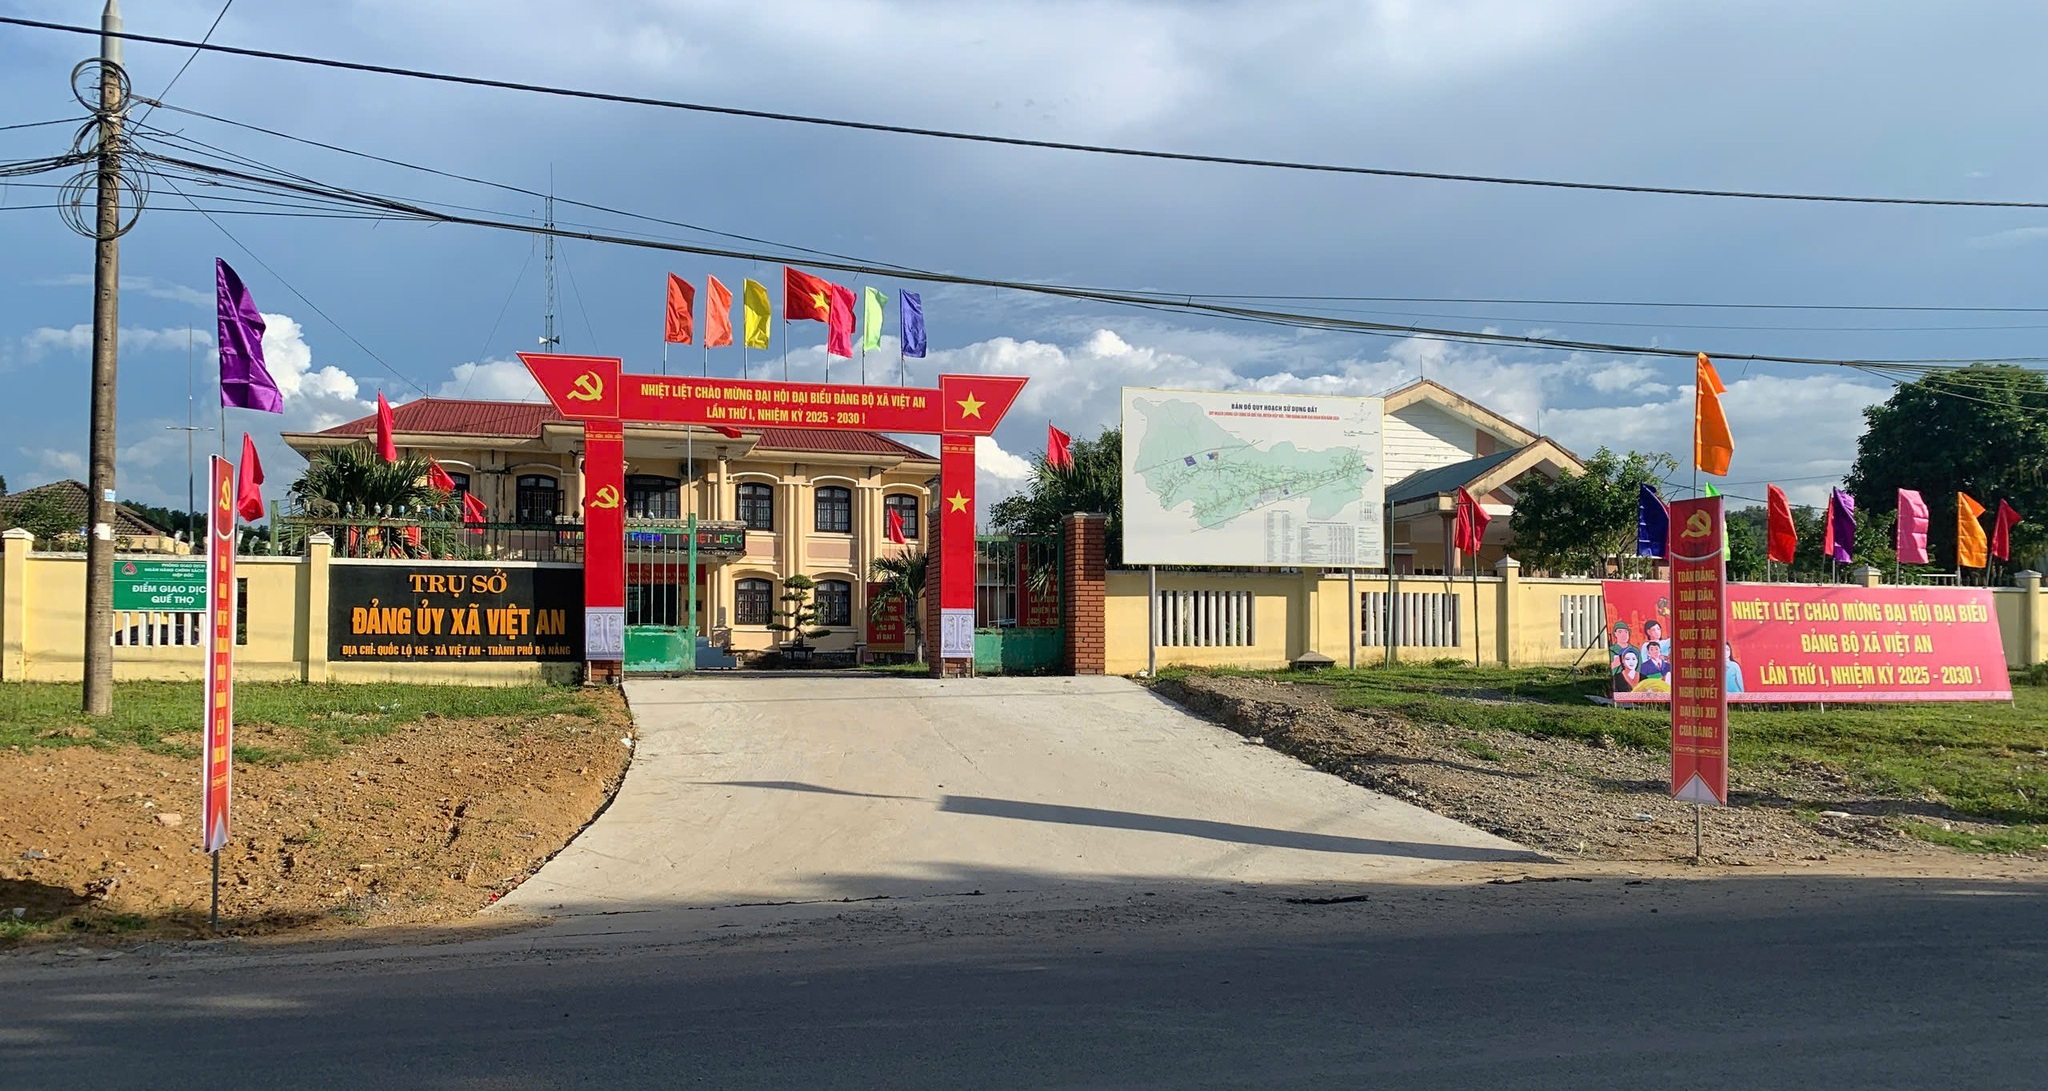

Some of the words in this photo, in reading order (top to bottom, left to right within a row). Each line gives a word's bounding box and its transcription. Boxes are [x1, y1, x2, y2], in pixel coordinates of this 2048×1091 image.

[641, 382, 669, 399] NHIỆT
[673, 383, 692, 400] LIỆT
[695, 385, 721, 399] CHÀO
[724, 386, 752, 401] MỪNG
[755, 389, 770, 404] ĐẠI
[774, 388, 789, 405] HỘI
[792, 391, 807, 405] ĐẠI
[810, 388, 831, 404] BIỂU
[834, 389, 859, 405] ĐẢNG
[862, 392, 874, 408] BỘ
[877, 394, 889, 406] XÃ
[891, 393, 910, 410] VIỆT
[913, 396, 925, 408] AN
[728, 405, 747, 419] THỨ
[749, 408, 755, 421] I,
[758, 407, 788, 423] NHIỆM
[791, 408, 803, 422] KỲ
[806, 411, 828, 423] 2025
[837, 412, 860, 424] 2030
[862, 413, 865, 424] !
[1677, 568, 1695, 582] TOÀN
[1695, 566, 1717, 581] ĐẢNG,
[132, 581, 156, 592] ĐIỂM
[159, 585, 186, 593] GIAO
[188, 586, 206, 595] DỊC
[410, 575, 467, 598] TRỤ
[472, 568, 507, 593] SỞ
[151, 593, 172, 603] QUẾ
[174, 596, 194, 605] THỌ
[1680, 588, 1696, 601] TOÀN
[1697, 587, 1715, 601] DÂN,
[352, 598, 411, 634] ĐẢNG
[417, 599, 444, 635] ỦY
[451, 603, 480, 635] XÃ
[487, 604, 530, 640] VIỆT
[536, 609, 565, 635] AN
[1679, 607, 1695, 620] TOÀN
[1696, 606, 1717, 621] QUÂN
[1731, 598, 1770, 624] NHIỆT
[1773, 598, 1800, 624] LIỆT
[1803, 599, 1839, 621] CHÀO
[1842, 599, 1882, 621] MỪNG
[1884, 604, 1907, 625] ĐẠI
[1909, 600, 1932, 626] HỘI
[1934, 605, 1956, 626] ĐẠI
[1958, 598, 1988, 622] BIỂU
[1680, 625, 1698, 641] QUYẾT
[1701, 626, 1717, 640] TÂM
[342, 645, 357, 657] ĐỊA
[359, 643, 376, 655] CHỈ:
[377, 642, 399, 655] QUỐC
[401, 644, 412, 657] LỘ
[415, 646, 428, 655] 14E
[449, 644, 466, 657] VIỆT
[469, 646, 480, 656] AN
[488, 644, 515, 656] THÀNH
[517, 642, 533, 655] PHỐ
[535, 644, 545, 655] ĐÀ
[1801, 628, 1839, 652] ĐẢNG
[1841, 631, 1860, 656] BỘ
[1862, 631, 1881, 652] XÃ
[1883, 631, 1910, 657] VIỆT
[1914, 635, 1933, 653] AN
[1681, 647, 1696, 662] THỰC
[1698, 646, 1715, 662] HIỆN
[1681, 663, 1702, 678] THẮNG
[1704, 667, 1716, 681] LỢI
[1790, 662, 1816, 685] THỨ
[1819, 666, 1829, 687] I,
[1831, 662, 1875, 688] NHIỆM
[1877, 662, 1894, 684] KỲ
[1898, 666, 1930, 684] 2025
[1941, 666, 1973, 684] 2030
[1975, 666, 1981, 684] !
[1679, 687, 1694, 700] NGHỊ
[1695, 684, 1718, 699] QUYẾT
[1680, 706, 1691, 719] ĐẠI
[1692, 704, 1703, 720] HỘI
[1706, 707, 1717, 718] XIV
[1679, 721, 1692, 736] CỦA
[1693, 722, 1712, 738] ĐẢNG
